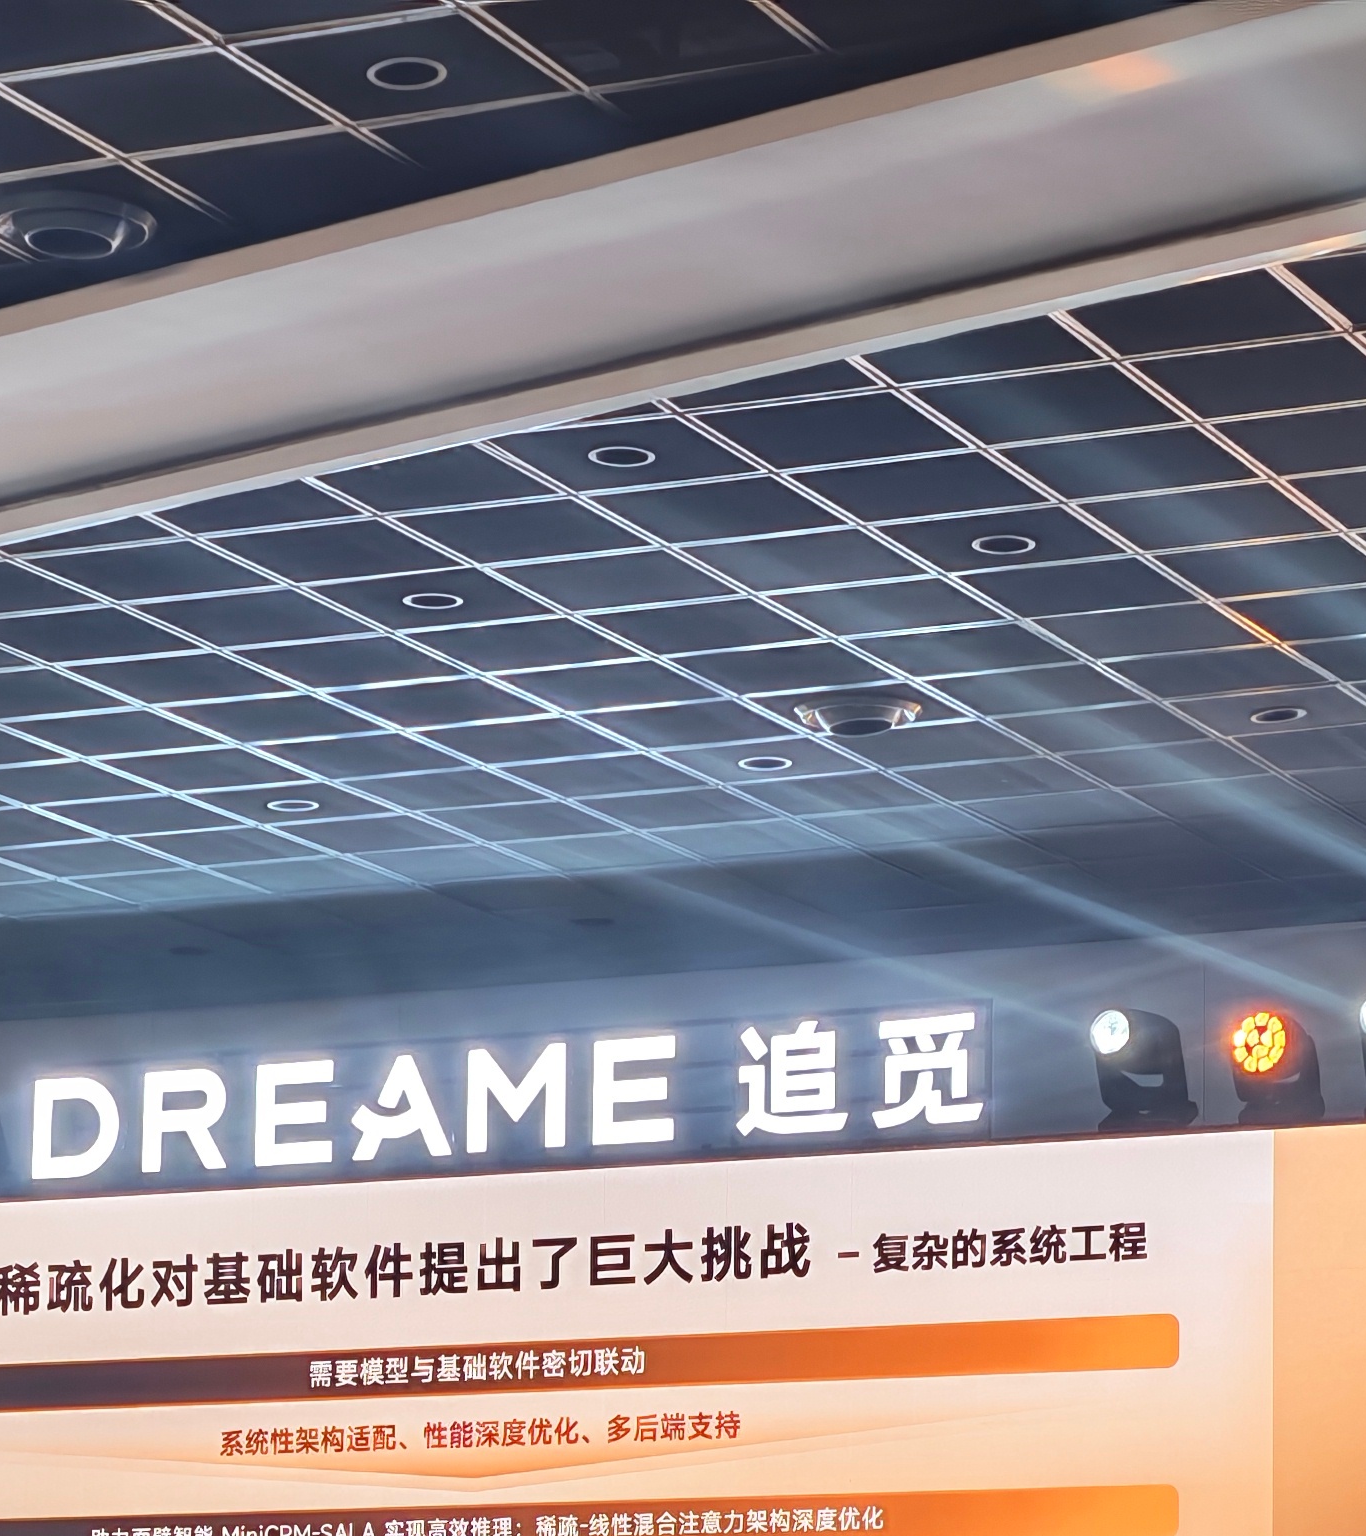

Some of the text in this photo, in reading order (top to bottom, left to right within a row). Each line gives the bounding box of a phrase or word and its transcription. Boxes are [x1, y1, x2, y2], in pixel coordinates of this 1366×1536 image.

[31, 1011, 985, 1180] DREAME 追觅
[871, 1222, 1147, 1273] 复杂的系统工程
[308, 1345, 647, 1389] 需要模型与基础软件密切联动
[219, 1411, 742, 1457] 系统性架构适配、性能深度优化、多后端支持
